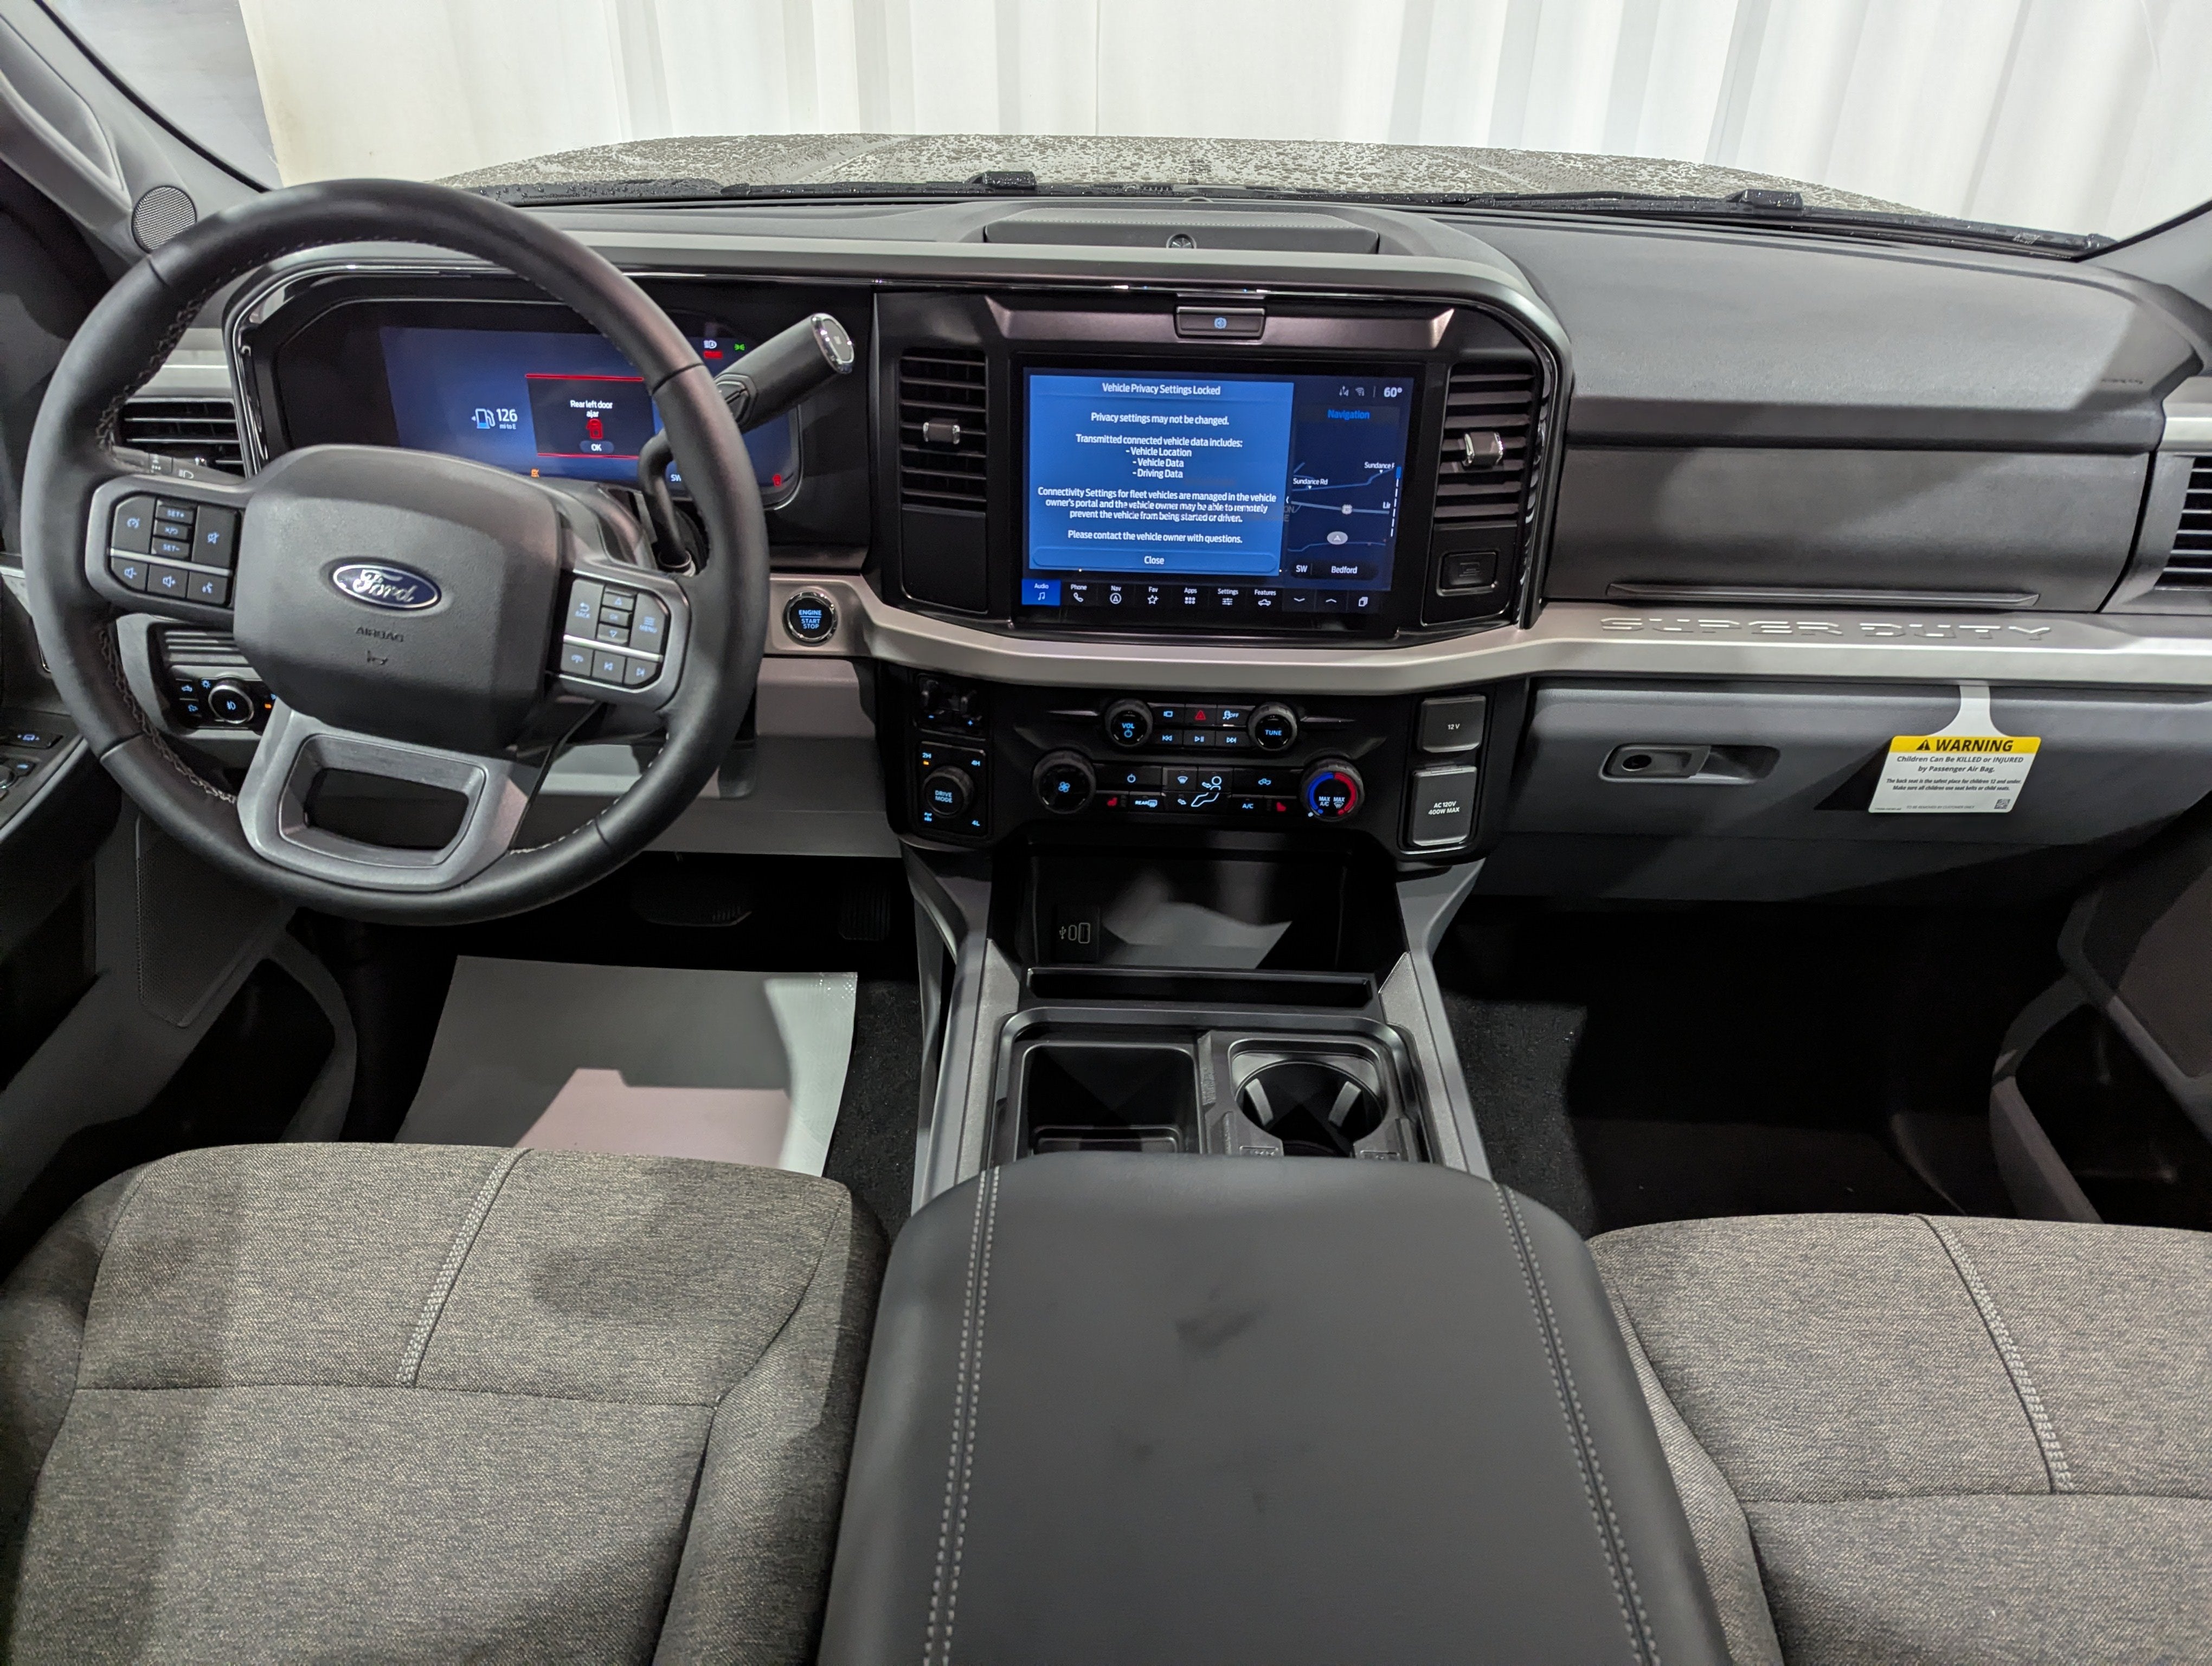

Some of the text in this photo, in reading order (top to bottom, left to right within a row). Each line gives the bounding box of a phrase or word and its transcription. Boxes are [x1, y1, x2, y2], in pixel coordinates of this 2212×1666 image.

[1102, 382, 1221, 396] Vehicle Privacy Settings Locked
[570, 400, 613, 409] Rear left door
[497, 408, 518, 422] 126
[586, 410, 599, 418] ajar
[1091, 412, 1230, 426] Privacy settings may not be changed.
[1328, 409, 1371, 421] Navigation
[1076, 434, 1243, 447] Transmitted connected vehicle data includes:
[1130, 447, 1192, 457] Vehicle Location
[1138, 458, 1184, 467] Vehicle Data
[1137, 469, 1183, 479] Driving Data
[1038, 487, 1084, 497] Connectivity
[1085, 489, 1117, 498] Settings
[1117, 489, 1129, 498] for
[1130, 490, 1147, 498] fleet
[1148, 490, 1178, 499] vehicles
[1192, 492, 1227, 502] managed
[1228, 492, 1236, 501] in
[1236, 493, 1249, 501] the
[1250, 493, 1277, 502] vehicle
[1045, 498, 1075, 507] owner's
[1075, 499, 1098, 509] portal
[1099, 500, 1114, 509] and
[1115, 500, 1128, 509] the
[1129, 501, 1154, 510] vehicle
[1179, 503, 1196, 512] may
[1197, 502, 1206, 511] be
[1207, 503, 1224, 511] able
[1225, 503, 1233, 511] to
[1234, 504, 1268, 514] remotely
[1069, 510, 1098, 519] prevent
[1099, 510, 1113, 518] the
[1113, 510, 1139, 520] vehicle
[1140, 511, 1158, 520] from
[1159, 512, 1180, 522] being
[1180, 512, 1208, 522] started
[1218, 514, 1243, 522] driven.
[1068, 530, 1092, 539] Please
[1093, 531, 1121, 540] contact
[1123, 531, 1135, 540] the
[1136, 532, 1162, 541] vehicle
[1187, 534, 1204, 542] with
[1205, 534, 1243, 543] questions.
[1144, 556, 1165, 565] Close
[353, 569, 417, 603] Ford
[1600, 617, 2051, 640] SUPER DUTY
[1935, 739, 2014, 752] WARNING
